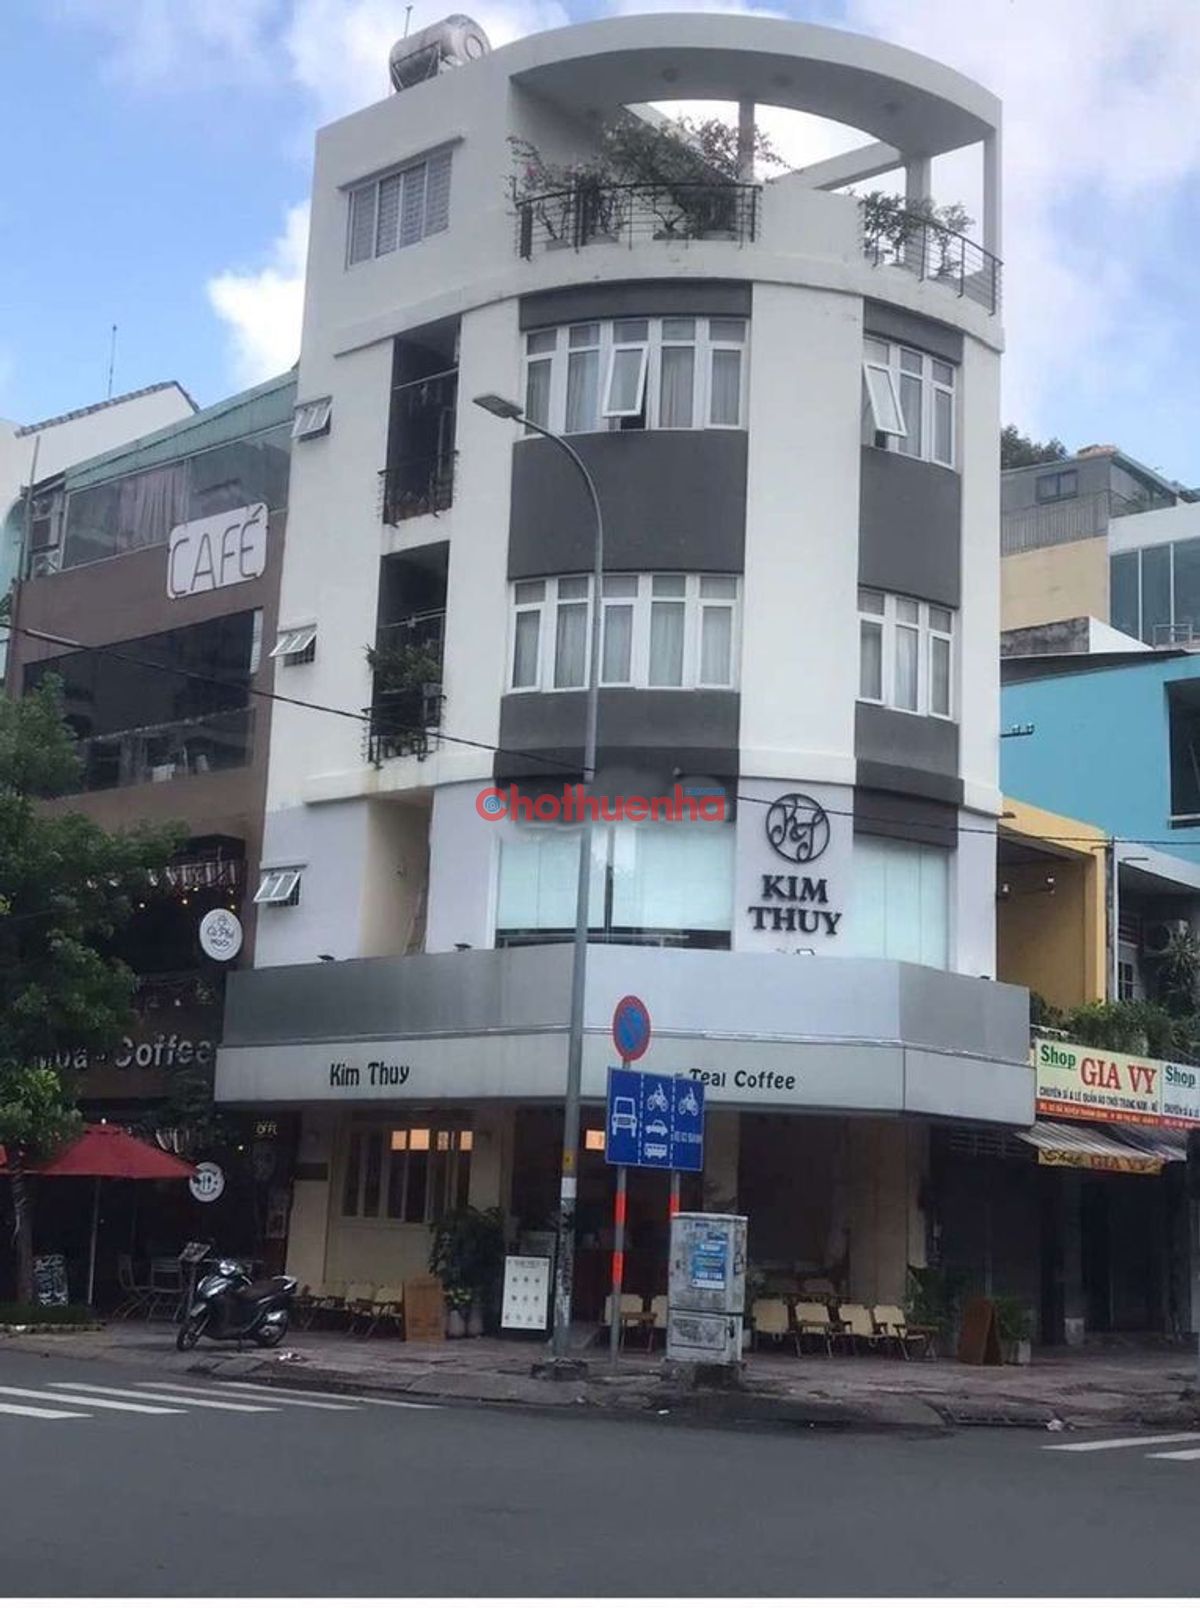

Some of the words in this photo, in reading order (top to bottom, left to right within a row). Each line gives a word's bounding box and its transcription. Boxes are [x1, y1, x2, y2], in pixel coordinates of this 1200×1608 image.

[171, 505, 264, 596] CAFÉ
[762, 875, 829, 904] KIM
[748, 906, 843, 936] THUY
[1041, 1044, 1077, 1070] Shop
[330, 1063, 360, 1087] Kim
[368, 1061, 411, 1086] Thuy
[735, 1070, 797, 1090] Coffee
[1081, 1057, 1122, 1091] GIA
[1127, 1064, 1158, 1095] VY
[1165, 1065, 1197, 1089] Shop
[1090, 1154, 1120, 1170] GIA
